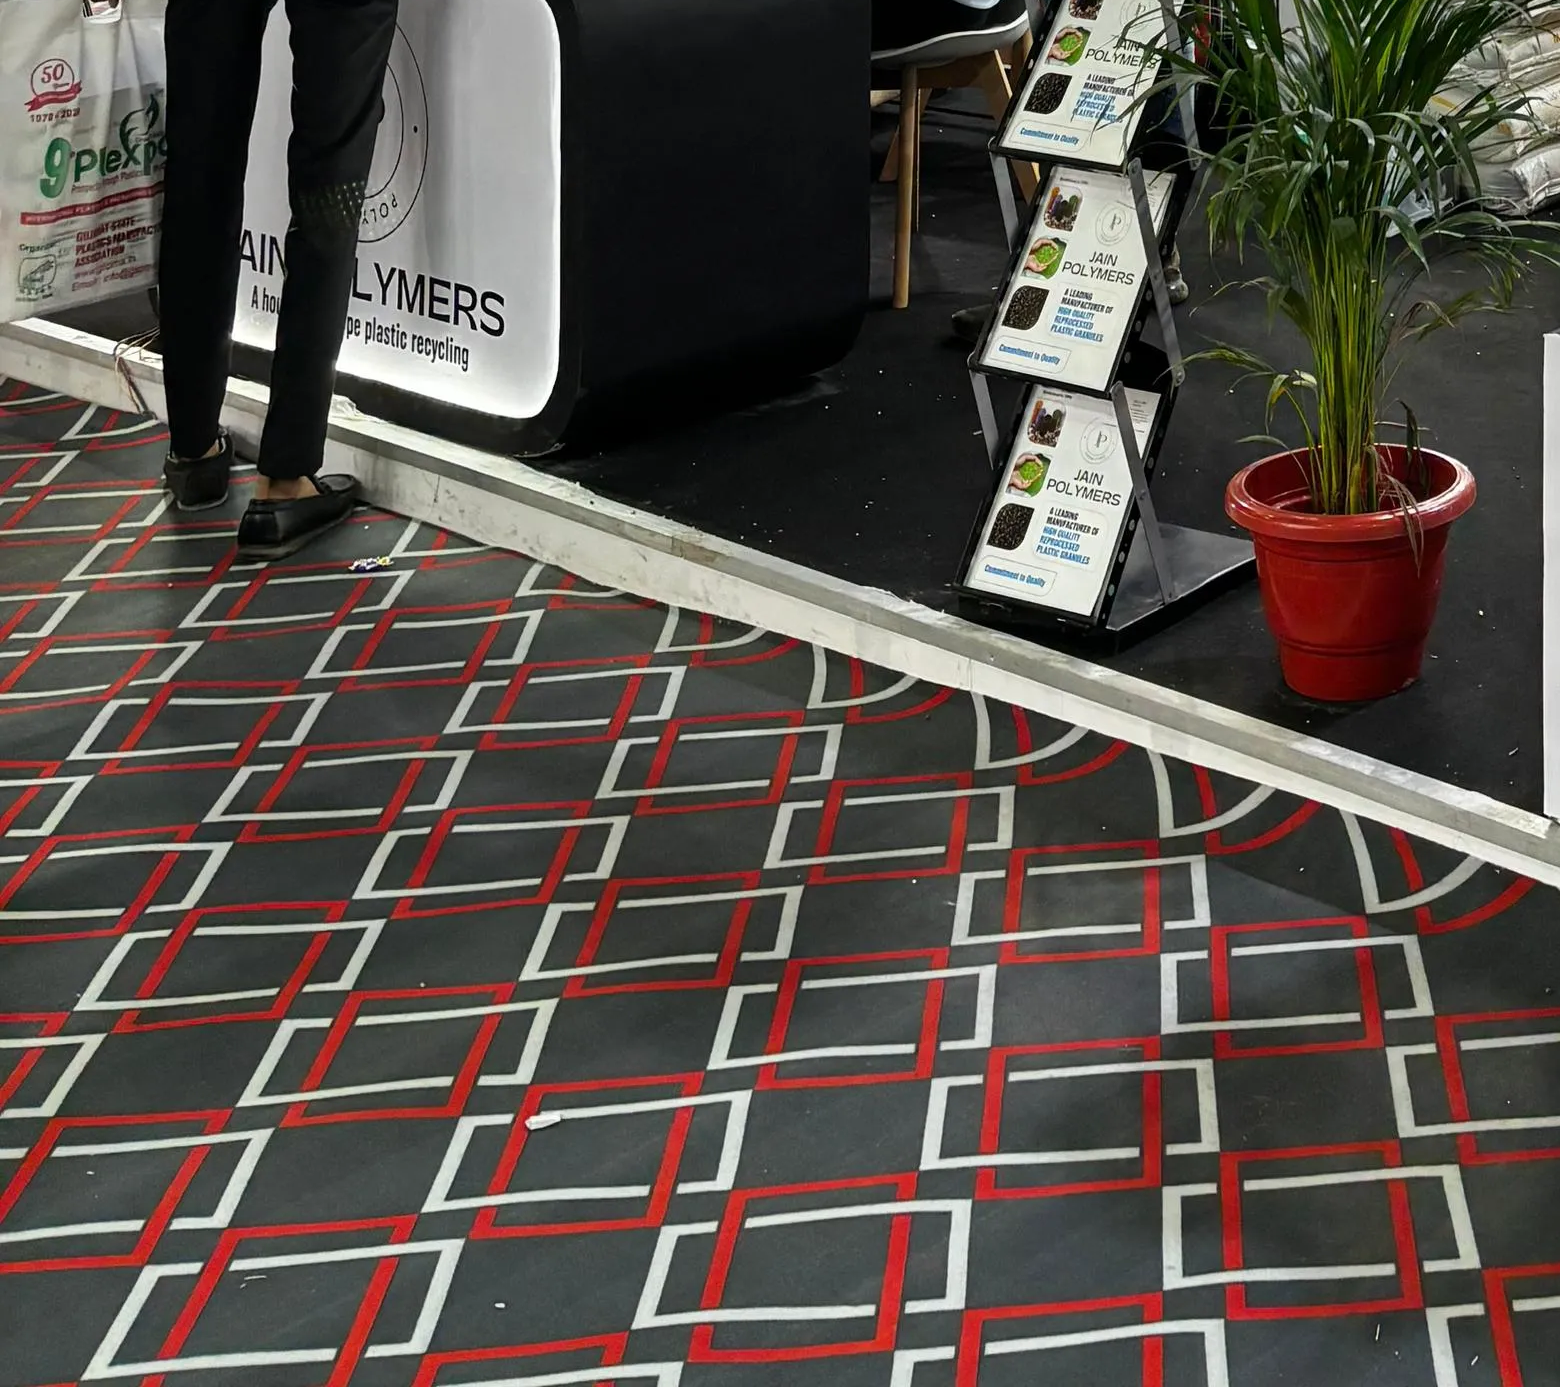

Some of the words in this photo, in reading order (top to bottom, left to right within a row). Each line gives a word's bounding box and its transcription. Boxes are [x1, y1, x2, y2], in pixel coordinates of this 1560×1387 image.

[41, 63, 64, 85] 50
[1089, 251, 1118, 266] JAIN
[239, 229, 287, 280] AIN
[352, 257, 506, 337] LYMERS
[1062, 261, 1135, 285] POLYMERS
[364, 315, 408, 350] plastic
[411, 330, 470, 372] recycling
[1074, 469, 1104, 486] JAIN
[1046, 479, 1122, 506] POLYMERS
